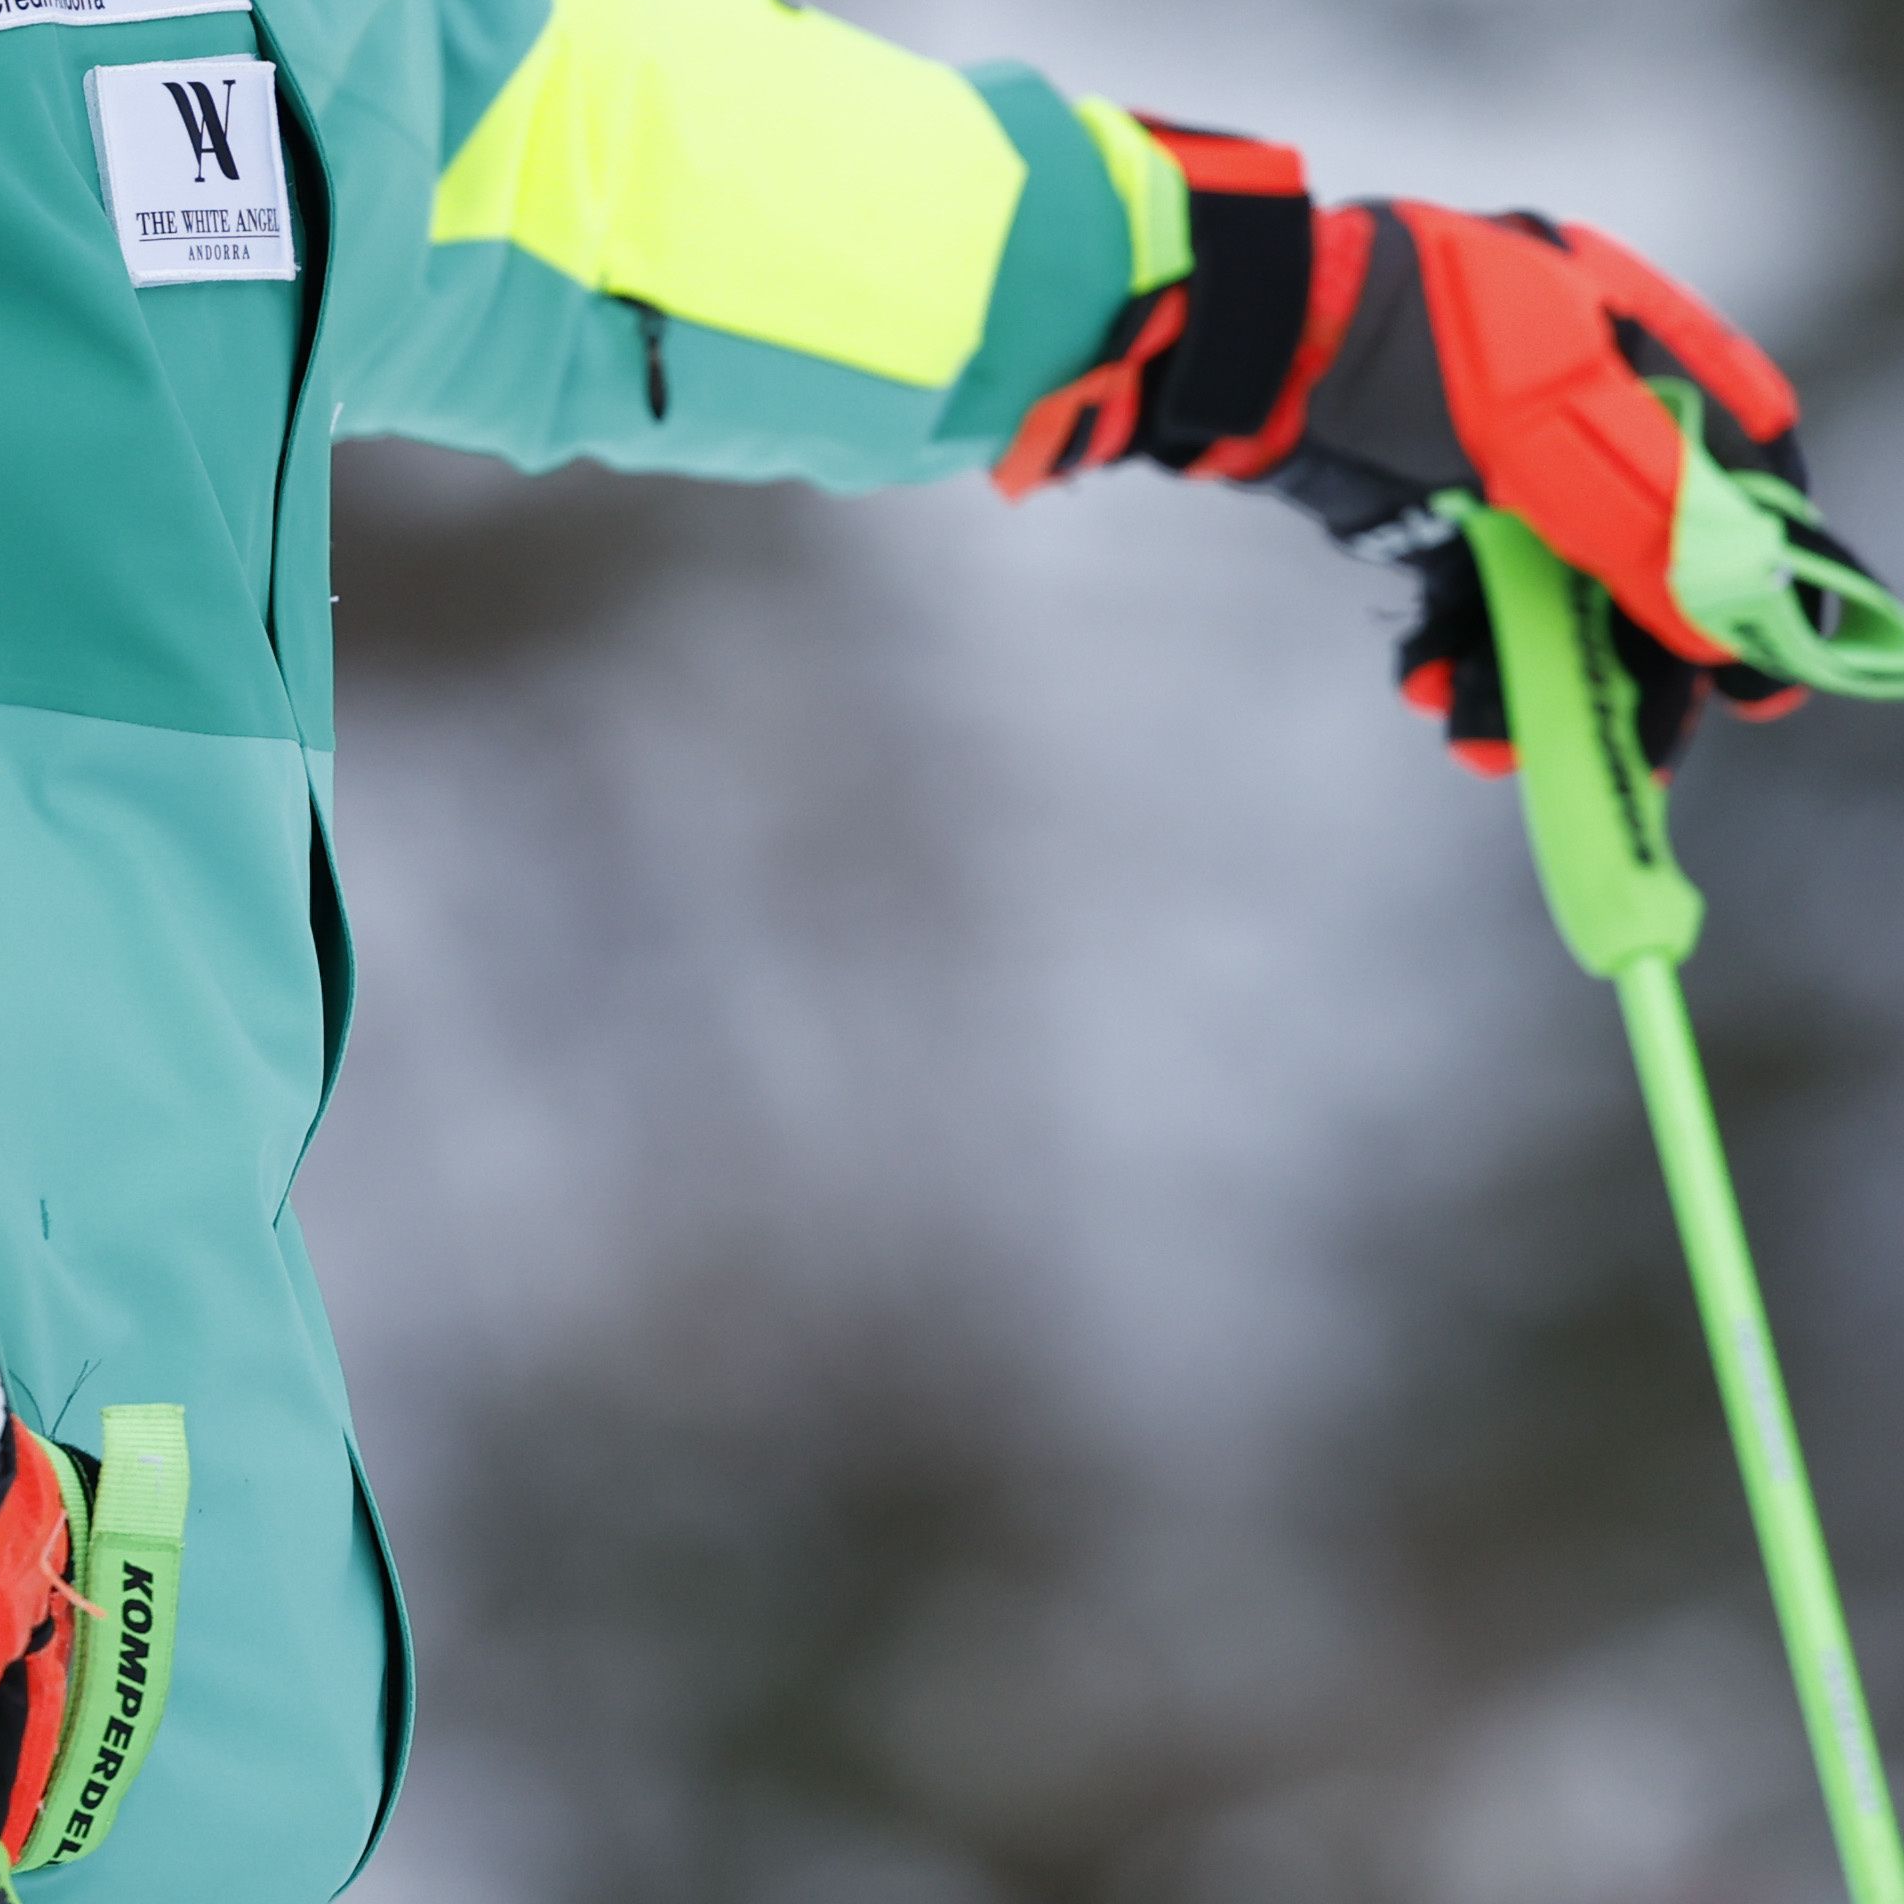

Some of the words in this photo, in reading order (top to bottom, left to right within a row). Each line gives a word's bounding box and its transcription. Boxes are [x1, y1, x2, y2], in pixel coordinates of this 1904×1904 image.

[136, 210, 178, 236] THE
[180, 208, 231, 234] WHITE
[235, 207, 280, 233] ANGEL
[188, 243, 251, 262] ANDORRA
[47, 1560, 154, 1866] KOMPERDEL
